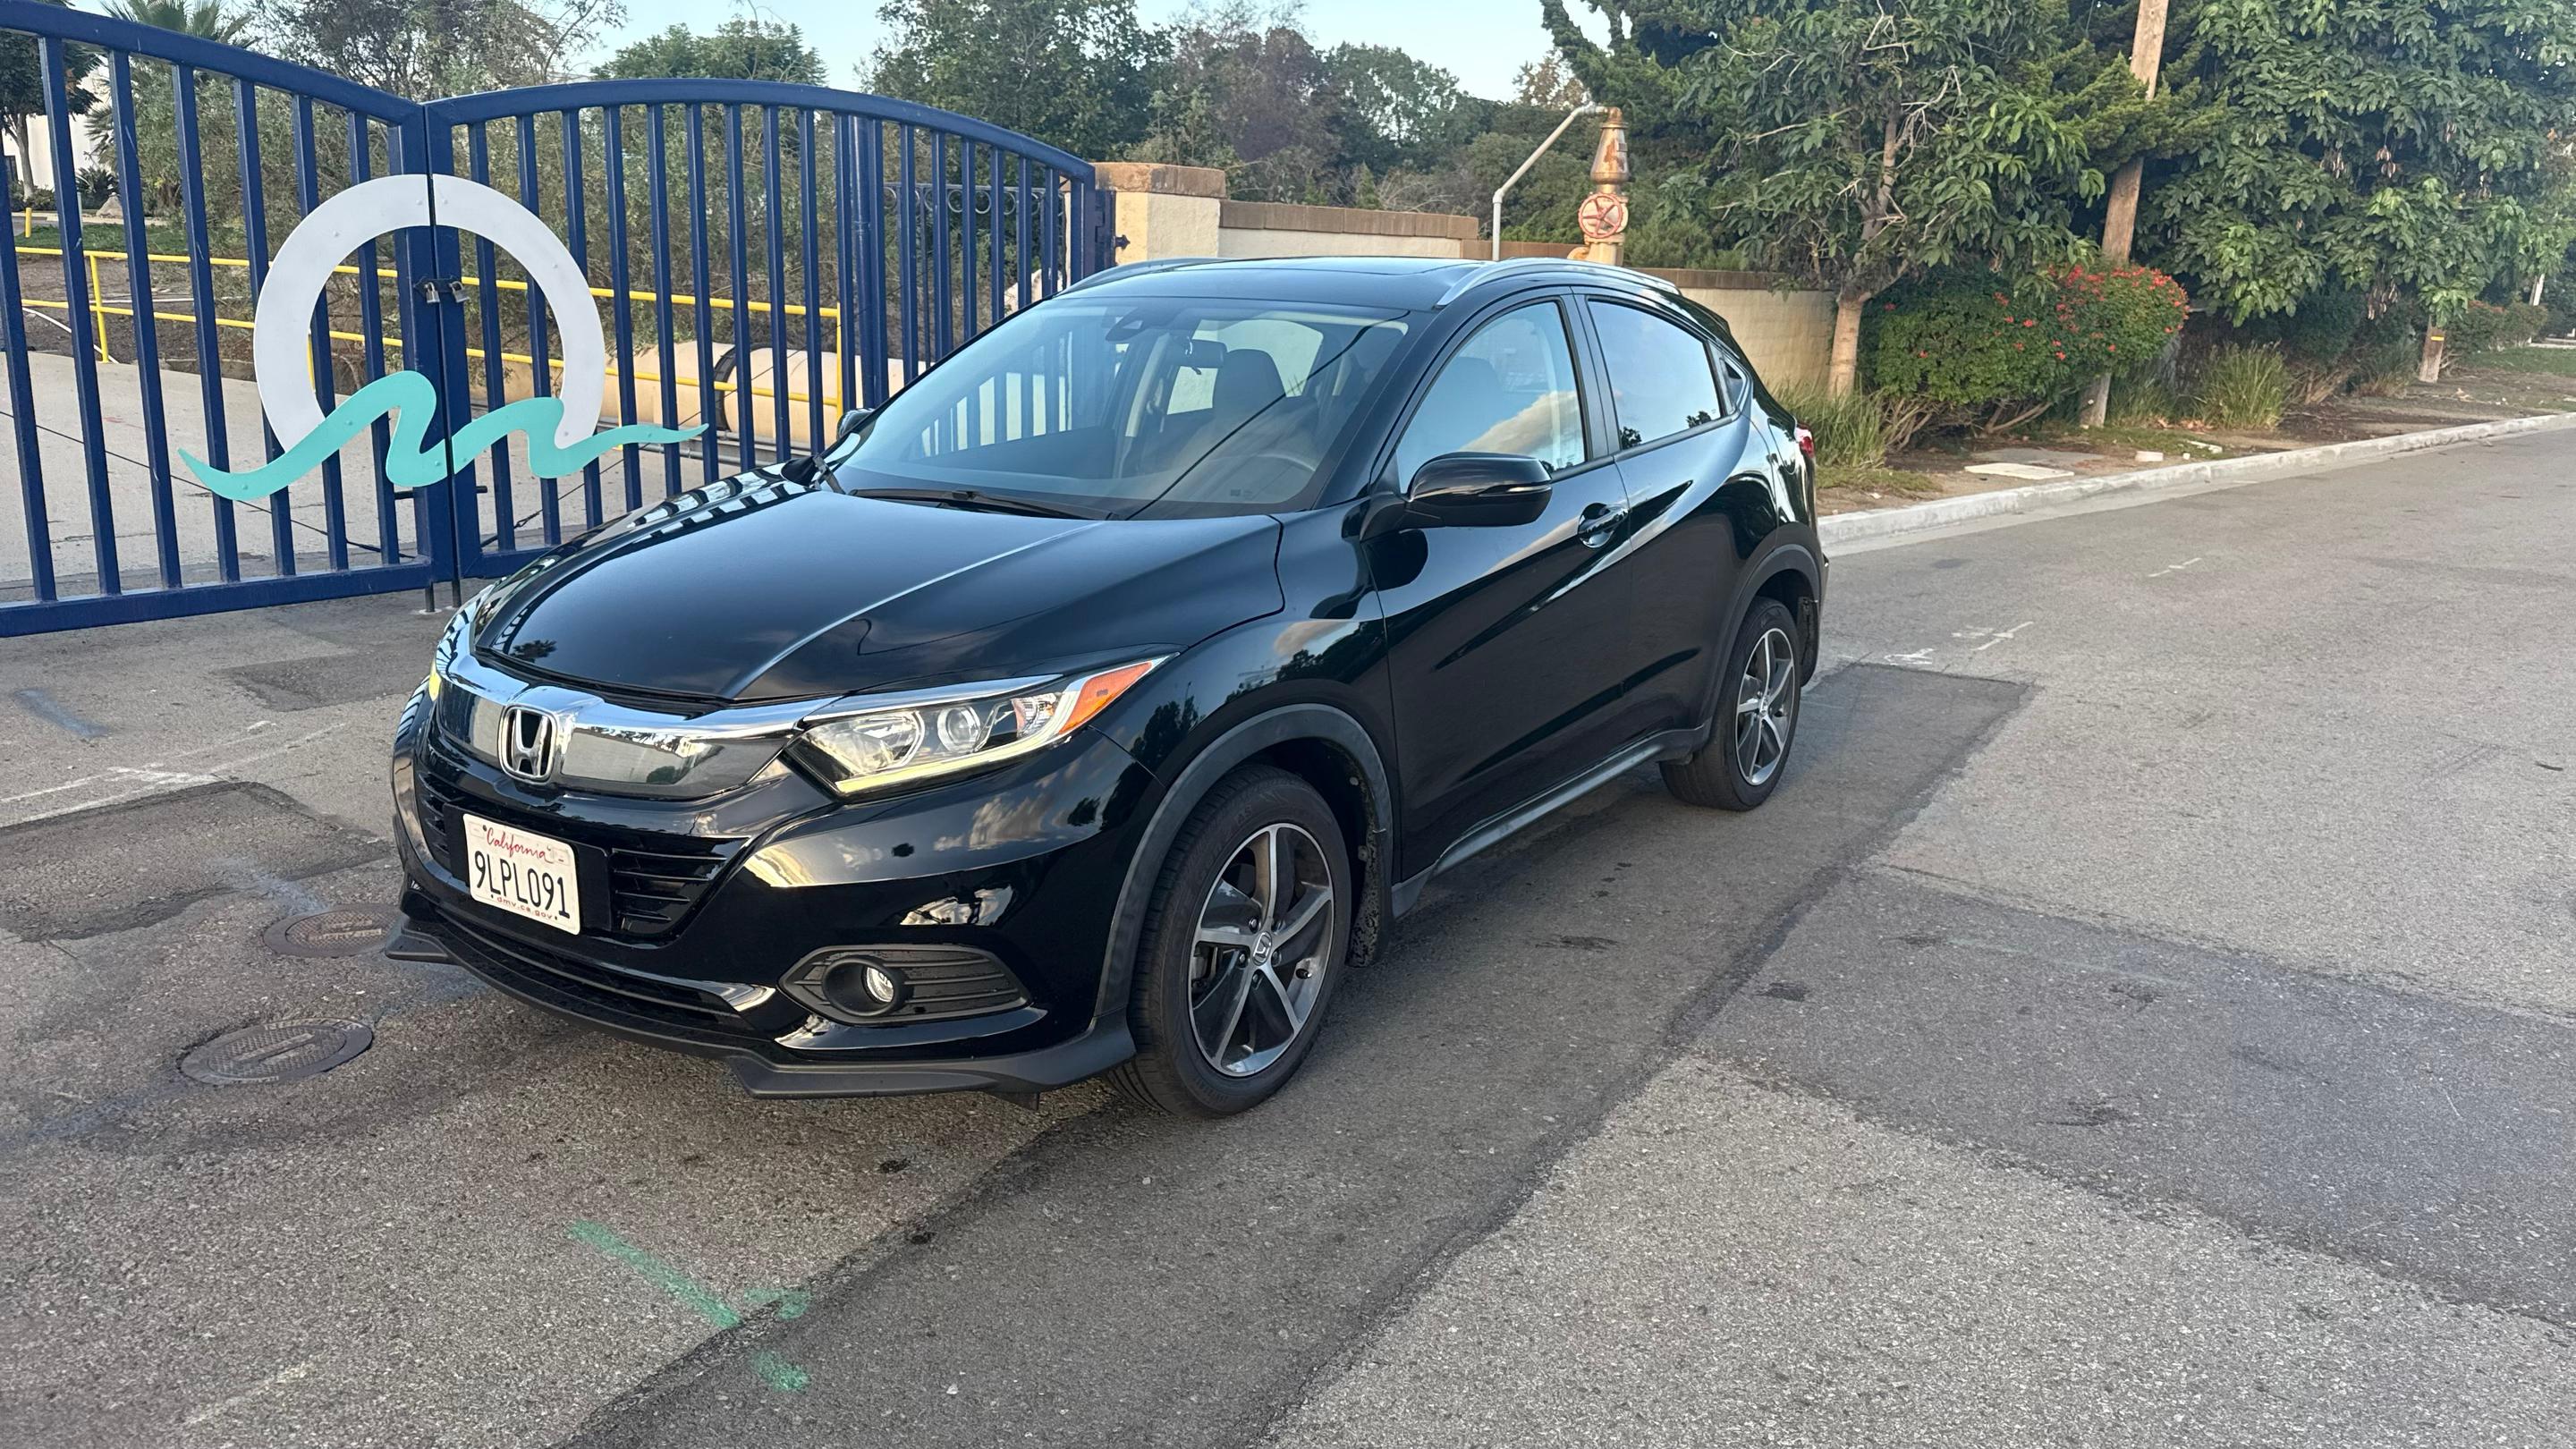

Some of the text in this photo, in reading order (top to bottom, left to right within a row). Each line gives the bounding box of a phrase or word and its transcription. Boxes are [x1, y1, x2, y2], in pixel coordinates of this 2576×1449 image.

[487, 827, 554, 864] California
[474, 851, 570, 919] 9LPL091
[496, 895, 553, 919] dmv.ca.gov
